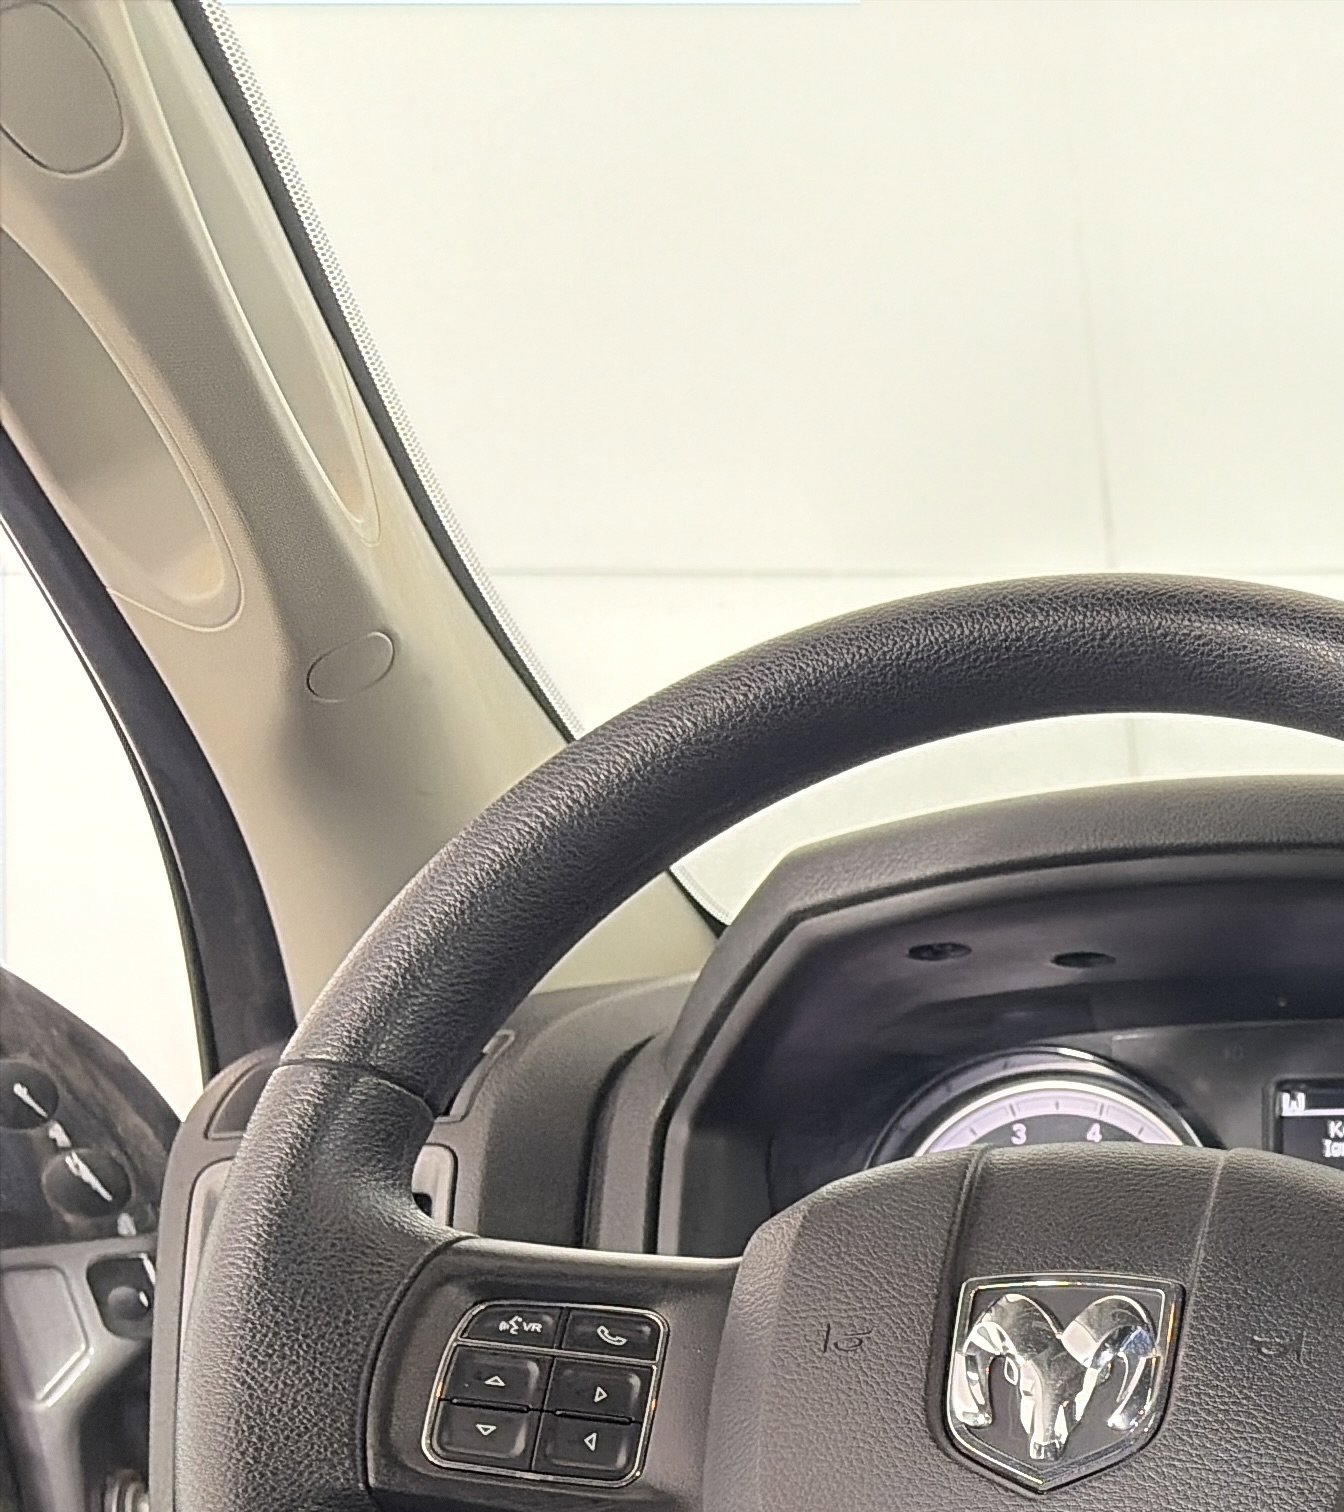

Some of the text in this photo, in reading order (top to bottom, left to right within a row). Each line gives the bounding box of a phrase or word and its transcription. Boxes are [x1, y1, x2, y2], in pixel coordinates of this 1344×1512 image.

[1281, 1091, 1306, 1113] W
[1011, 1123, 1027, 1145] 3
[1086, 1123, 1102, 1143] 4
[522, 1321, 543, 1333] VR
